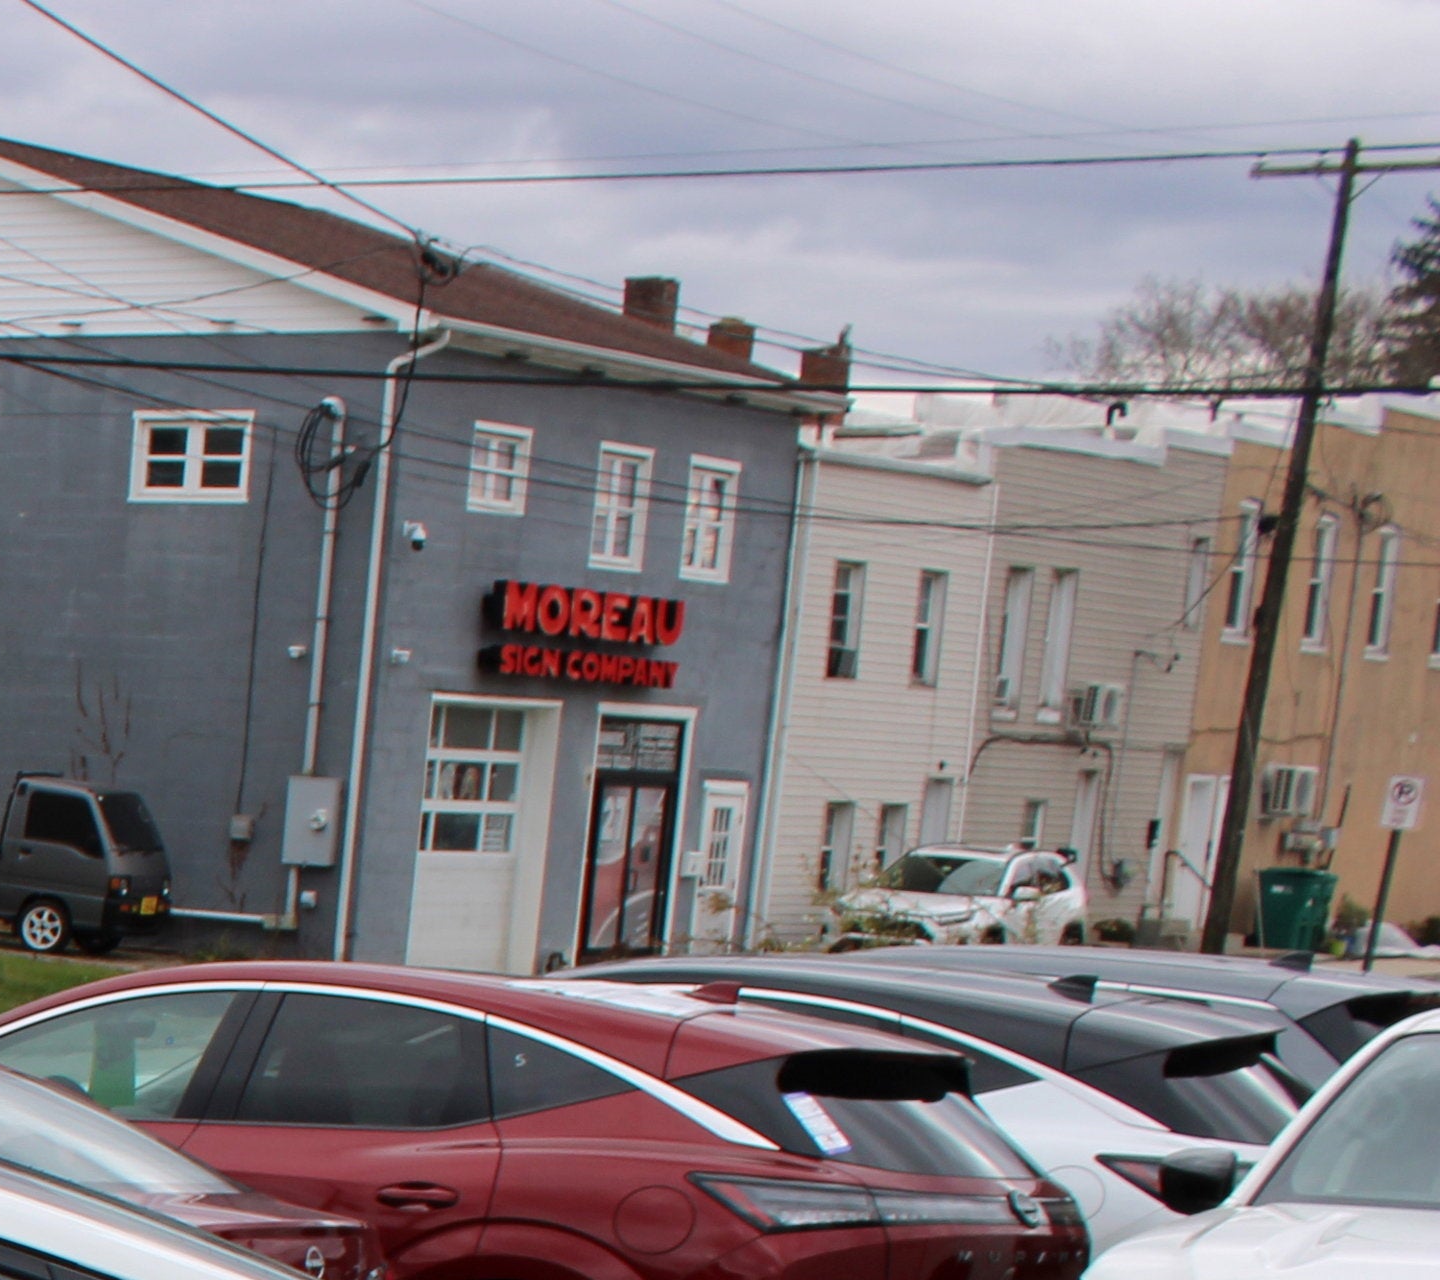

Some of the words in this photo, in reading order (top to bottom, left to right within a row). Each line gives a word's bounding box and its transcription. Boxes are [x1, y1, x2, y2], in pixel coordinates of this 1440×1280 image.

[503, 580, 685, 646] MOREAU
[500, 644, 560, 677] SIGN
[566, 652, 679, 689] COMPANY
